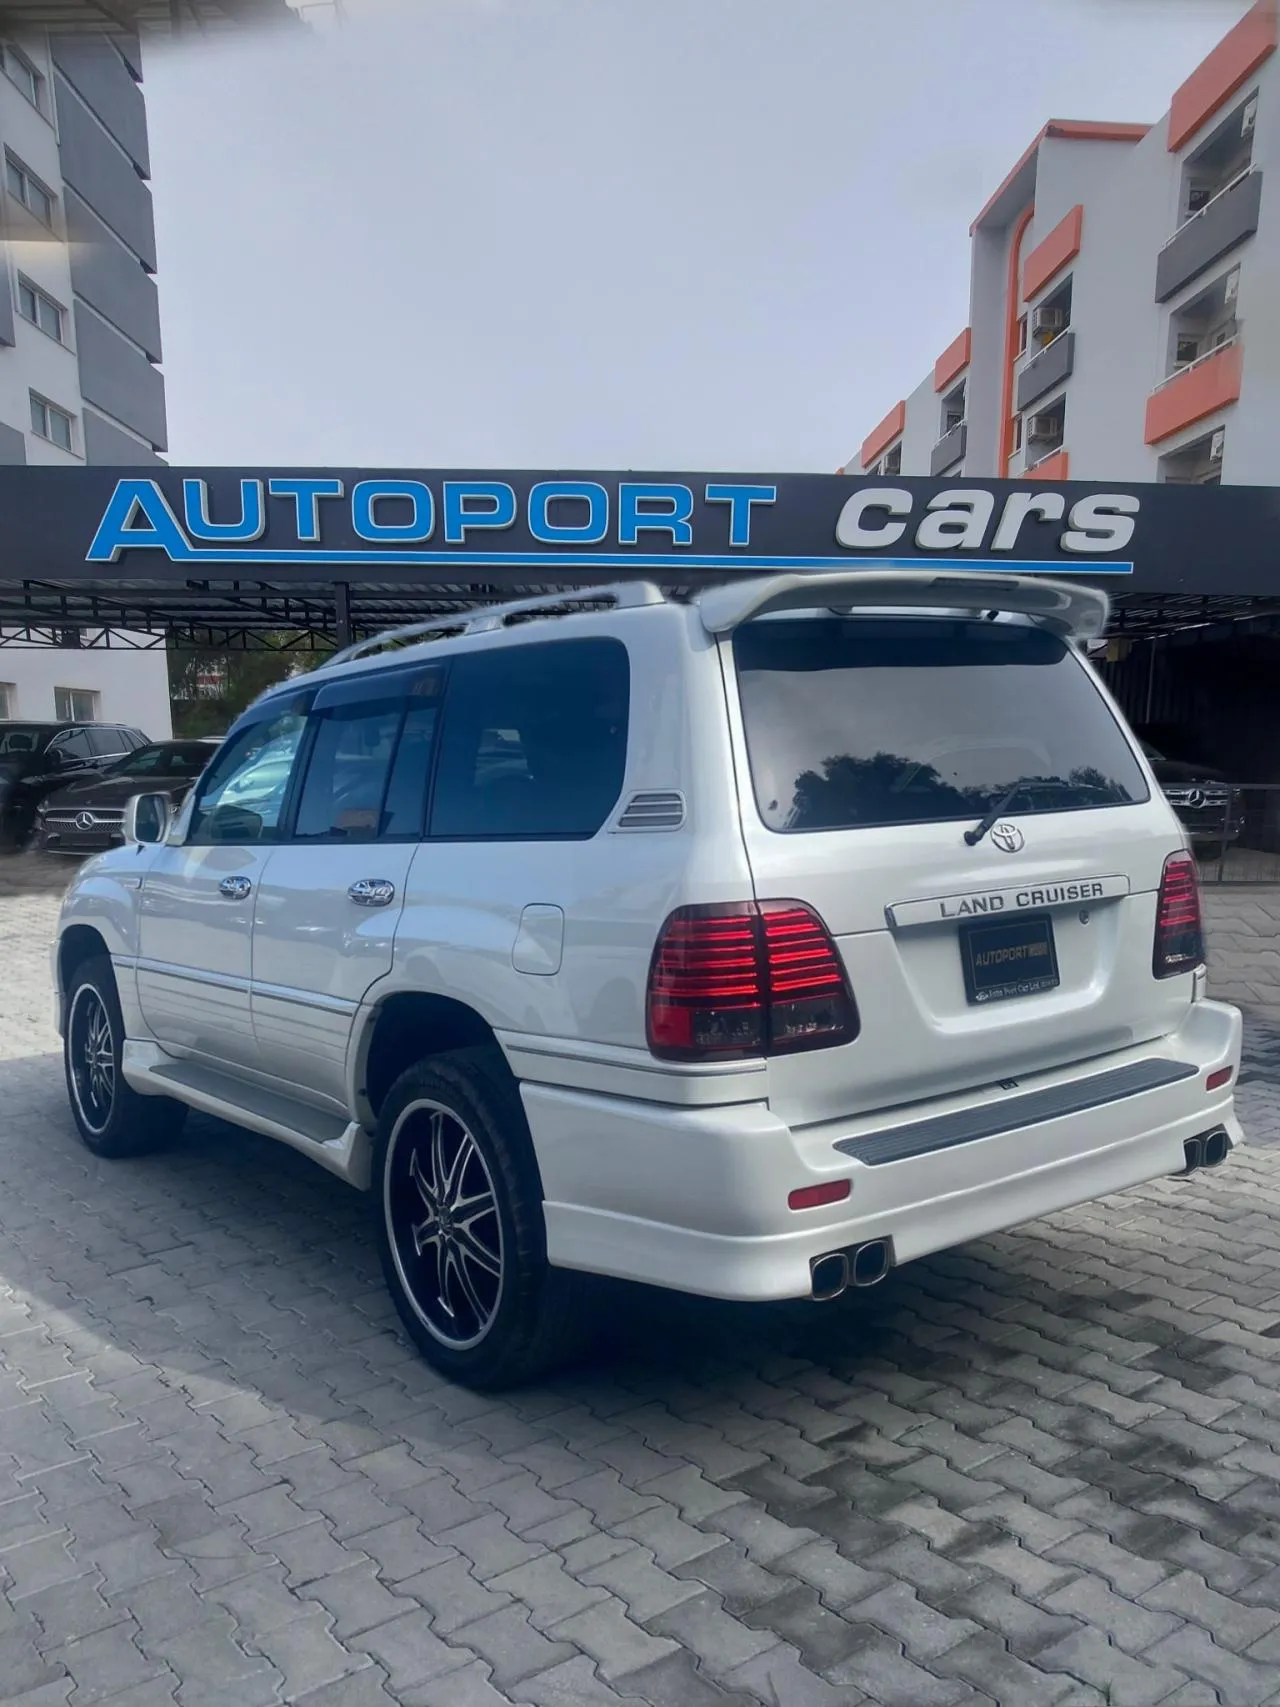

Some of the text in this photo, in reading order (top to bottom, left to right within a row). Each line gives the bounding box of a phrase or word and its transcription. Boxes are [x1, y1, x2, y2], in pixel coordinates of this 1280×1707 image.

[85, 477, 1141, 563] AUTOPORT cars
[940, 883, 1103, 918] LAND CRUISER
[976, 944, 1029, 967] AUTOPORT
